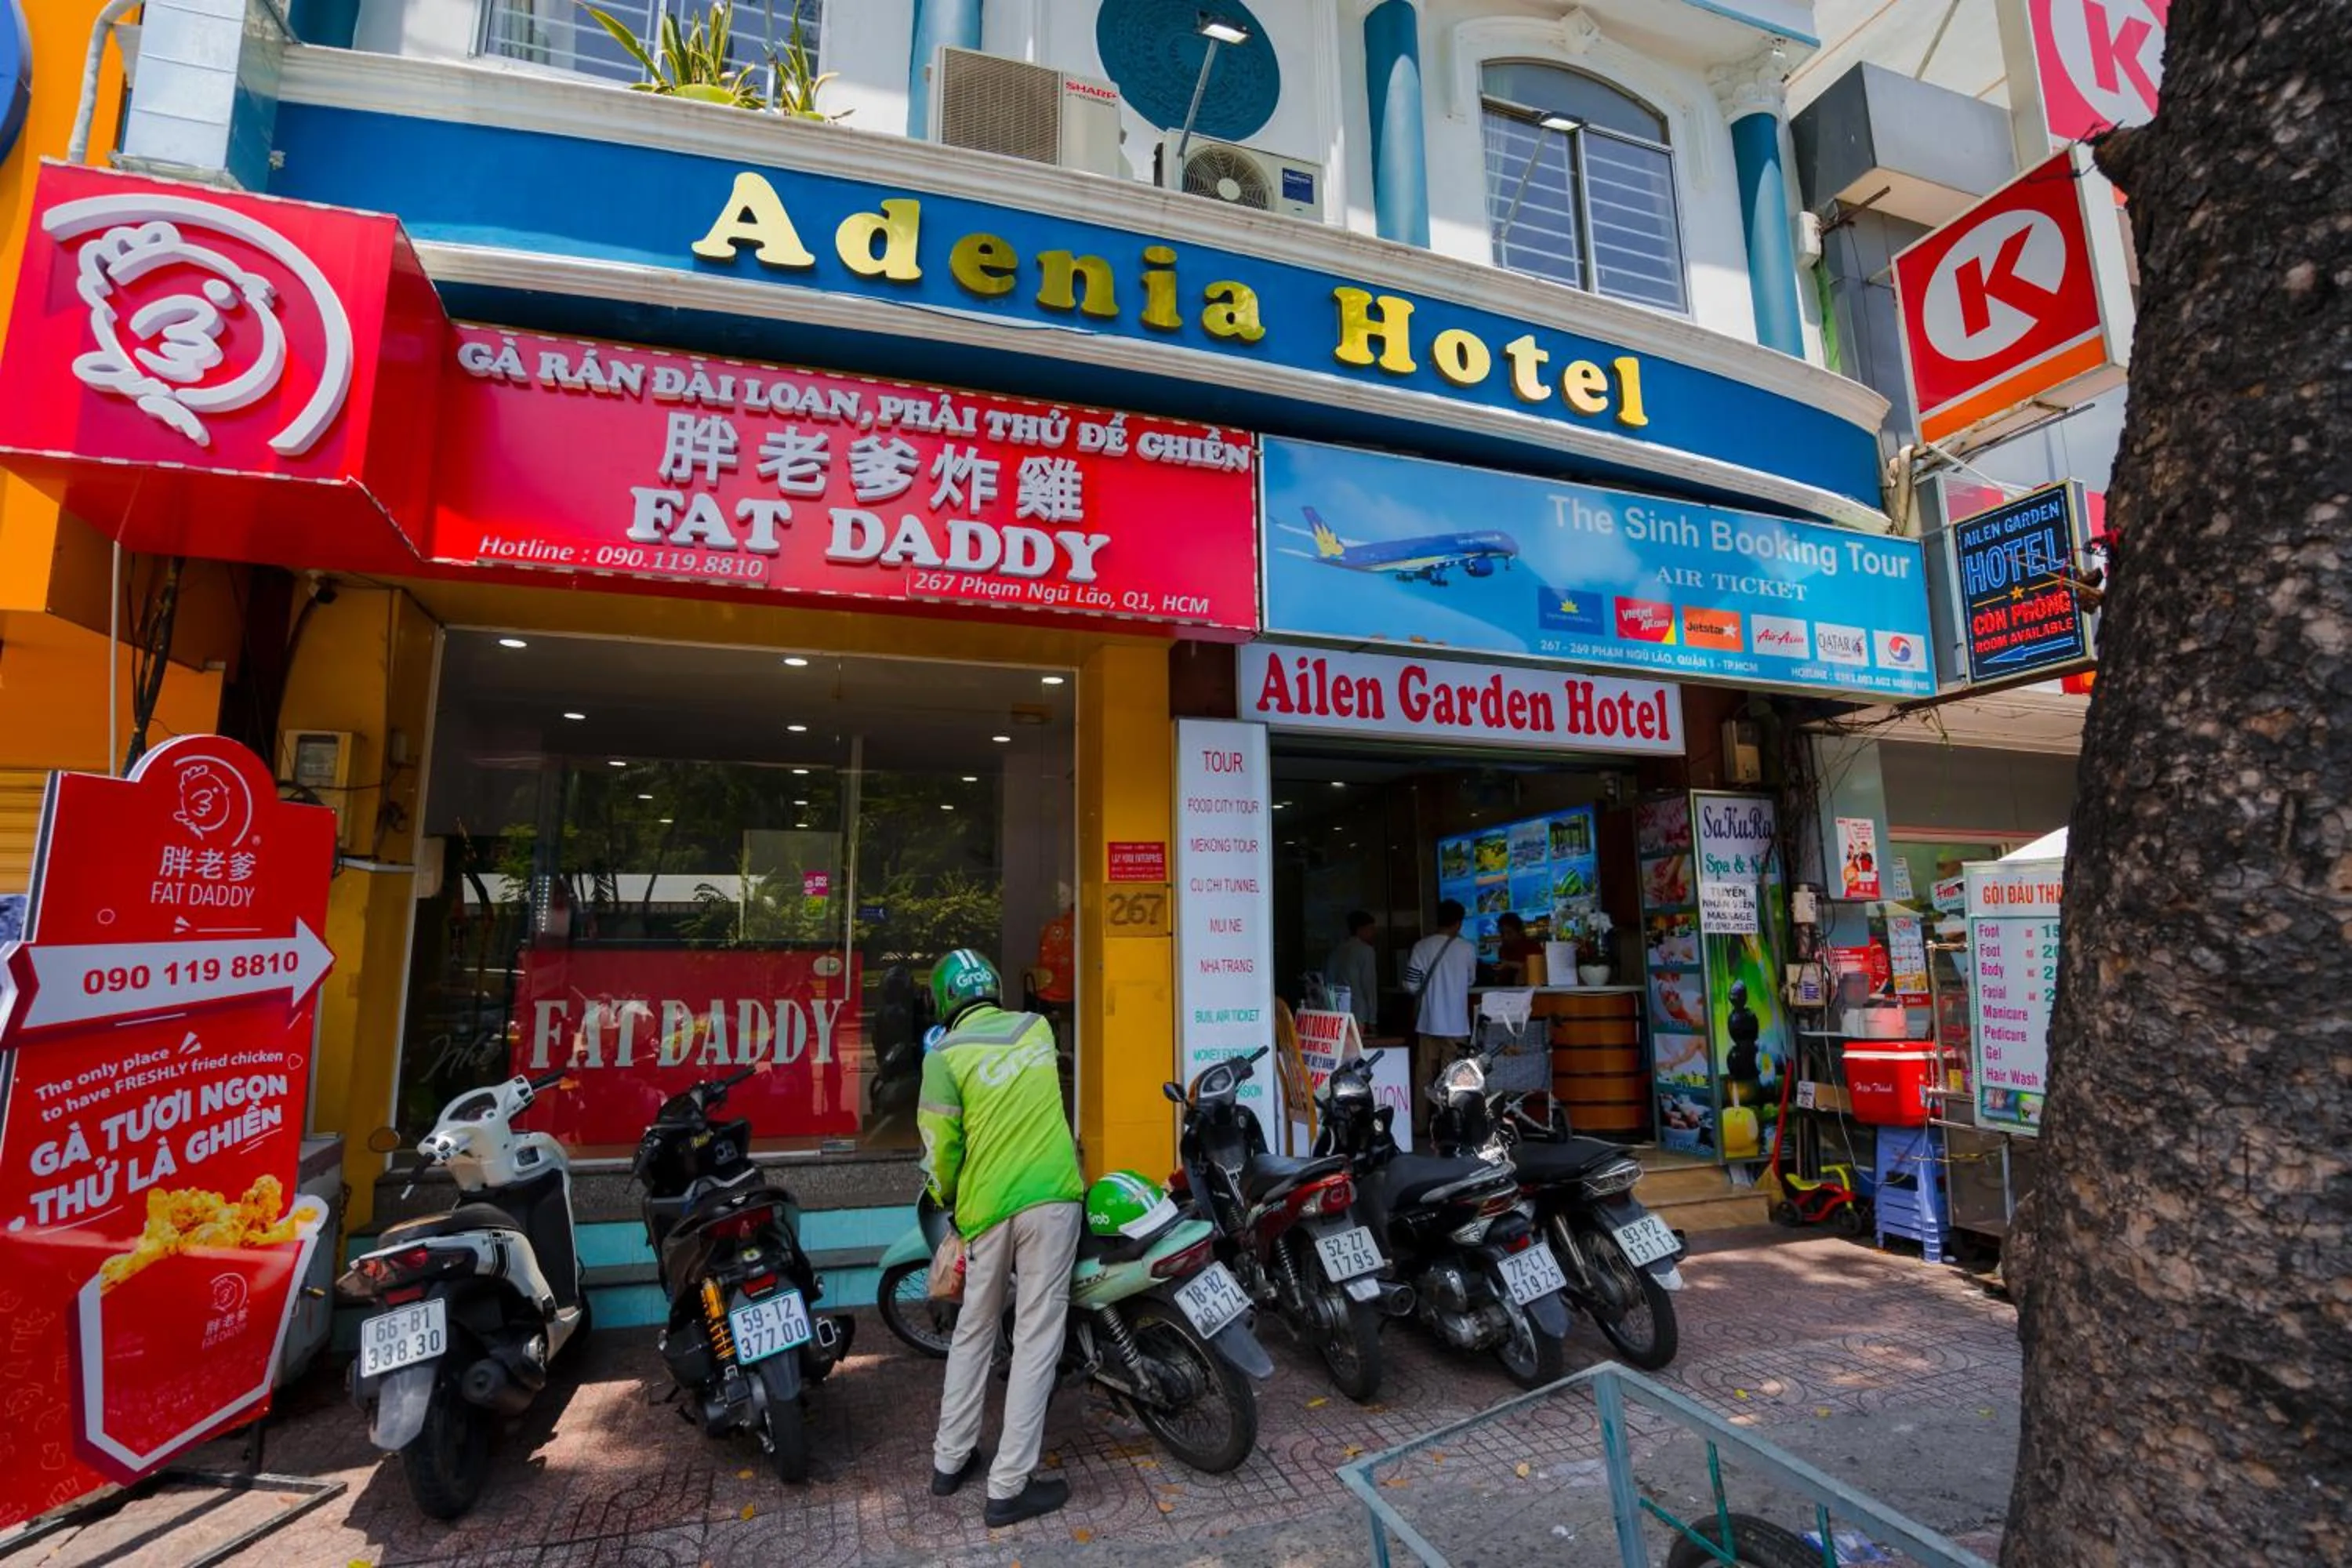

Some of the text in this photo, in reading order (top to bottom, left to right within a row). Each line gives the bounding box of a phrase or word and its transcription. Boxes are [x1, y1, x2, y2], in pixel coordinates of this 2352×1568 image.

[1065, 81, 1117, 98] SHARP
[691, 171, 1649, 427] Adenia Hotel
[457, 337, 528, 380] GÀ
[538, 349, 645, 397] RÁN
[652, 362, 736, 405] ĐÀI
[877, 394, 978, 435] PHẢI
[659, 412, 1084, 522] 胖老爹炸雞
[626, 486, 1111, 583] FAT DADDY
[1547, 494, 1911, 579] The Sinh Booking Tour
[1963, 500, 2060, 549] AILEN GARDEN
[479, 535, 575, 561] Hotline
[597, 546, 764, 579] 090.119.8810
[1964, 528, 2066, 596] HOTEL
[913, 572, 1210, 615] 267 Phạm Ngũ Lão, Q1, HCM
[1655, 565, 1808, 602] AIR TICKET
[1972, 604, 2008, 636] CÒN
[1975, 616, 2074, 653] ROOM AVAILABLE
[1817, 632, 1851, 652] QATAR
[1256, 652, 1671, 741] Ailen Garden Hotel
[1202, 750, 1243, 773] TOUR
[1187, 797, 1259, 815] FOOD CITY TOUR
[159, 845, 256, 882] 胖老爹
[1190, 837, 1259, 853] MEKONG TOUR
[1705, 852, 1730, 881] Spa
[1733, 852, 1745, 874] &
[150, 880, 256, 907] FAT DADDY
[1224, 878, 1260, 894] TUNNEL
[1107, 891, 1165, 926] 267
[1200, 959, 1254, 973] NHA TRANG
[1980, 943, 2001, 957] Foot
[83, 951, 299, 996] 090 119 8810
[956, 967, 993, 988] Grab
[1981, 962, 2005, 978] Body
[529, 998, 653, 1070] FAT
[656, 998, 845, 1067] DADDY
[1231, 1009, 1261, 1023] TICKET
[1985, 1044, 2002, 1060] Gel
[34, 1047, 170, 1101] The only place
[41, 1050, 284, 1123] to have FRESHLY fried chicken
[1985, 1066, 2039, 1087] Hair Wash
[29, 1120, 93, 1177] GÀ
[100, 1088, 192, 1152] TƯƠI
[29, 1100, 282, 1225] THỬ LÀ GHIỀN
[1332, 1250, 1374, 1276] 1795
[1185, 1270, 1228, 1308] 18-B2
[1512, 1266, 1561, 1301] 519.25
[376, 1307, 432, 1343] 66-B1
[740, 1298, 794, 1332] 59-T2
[368, 1329, 441, 1370] 338.30
[740, 1317, 806, 1359] 377.00
